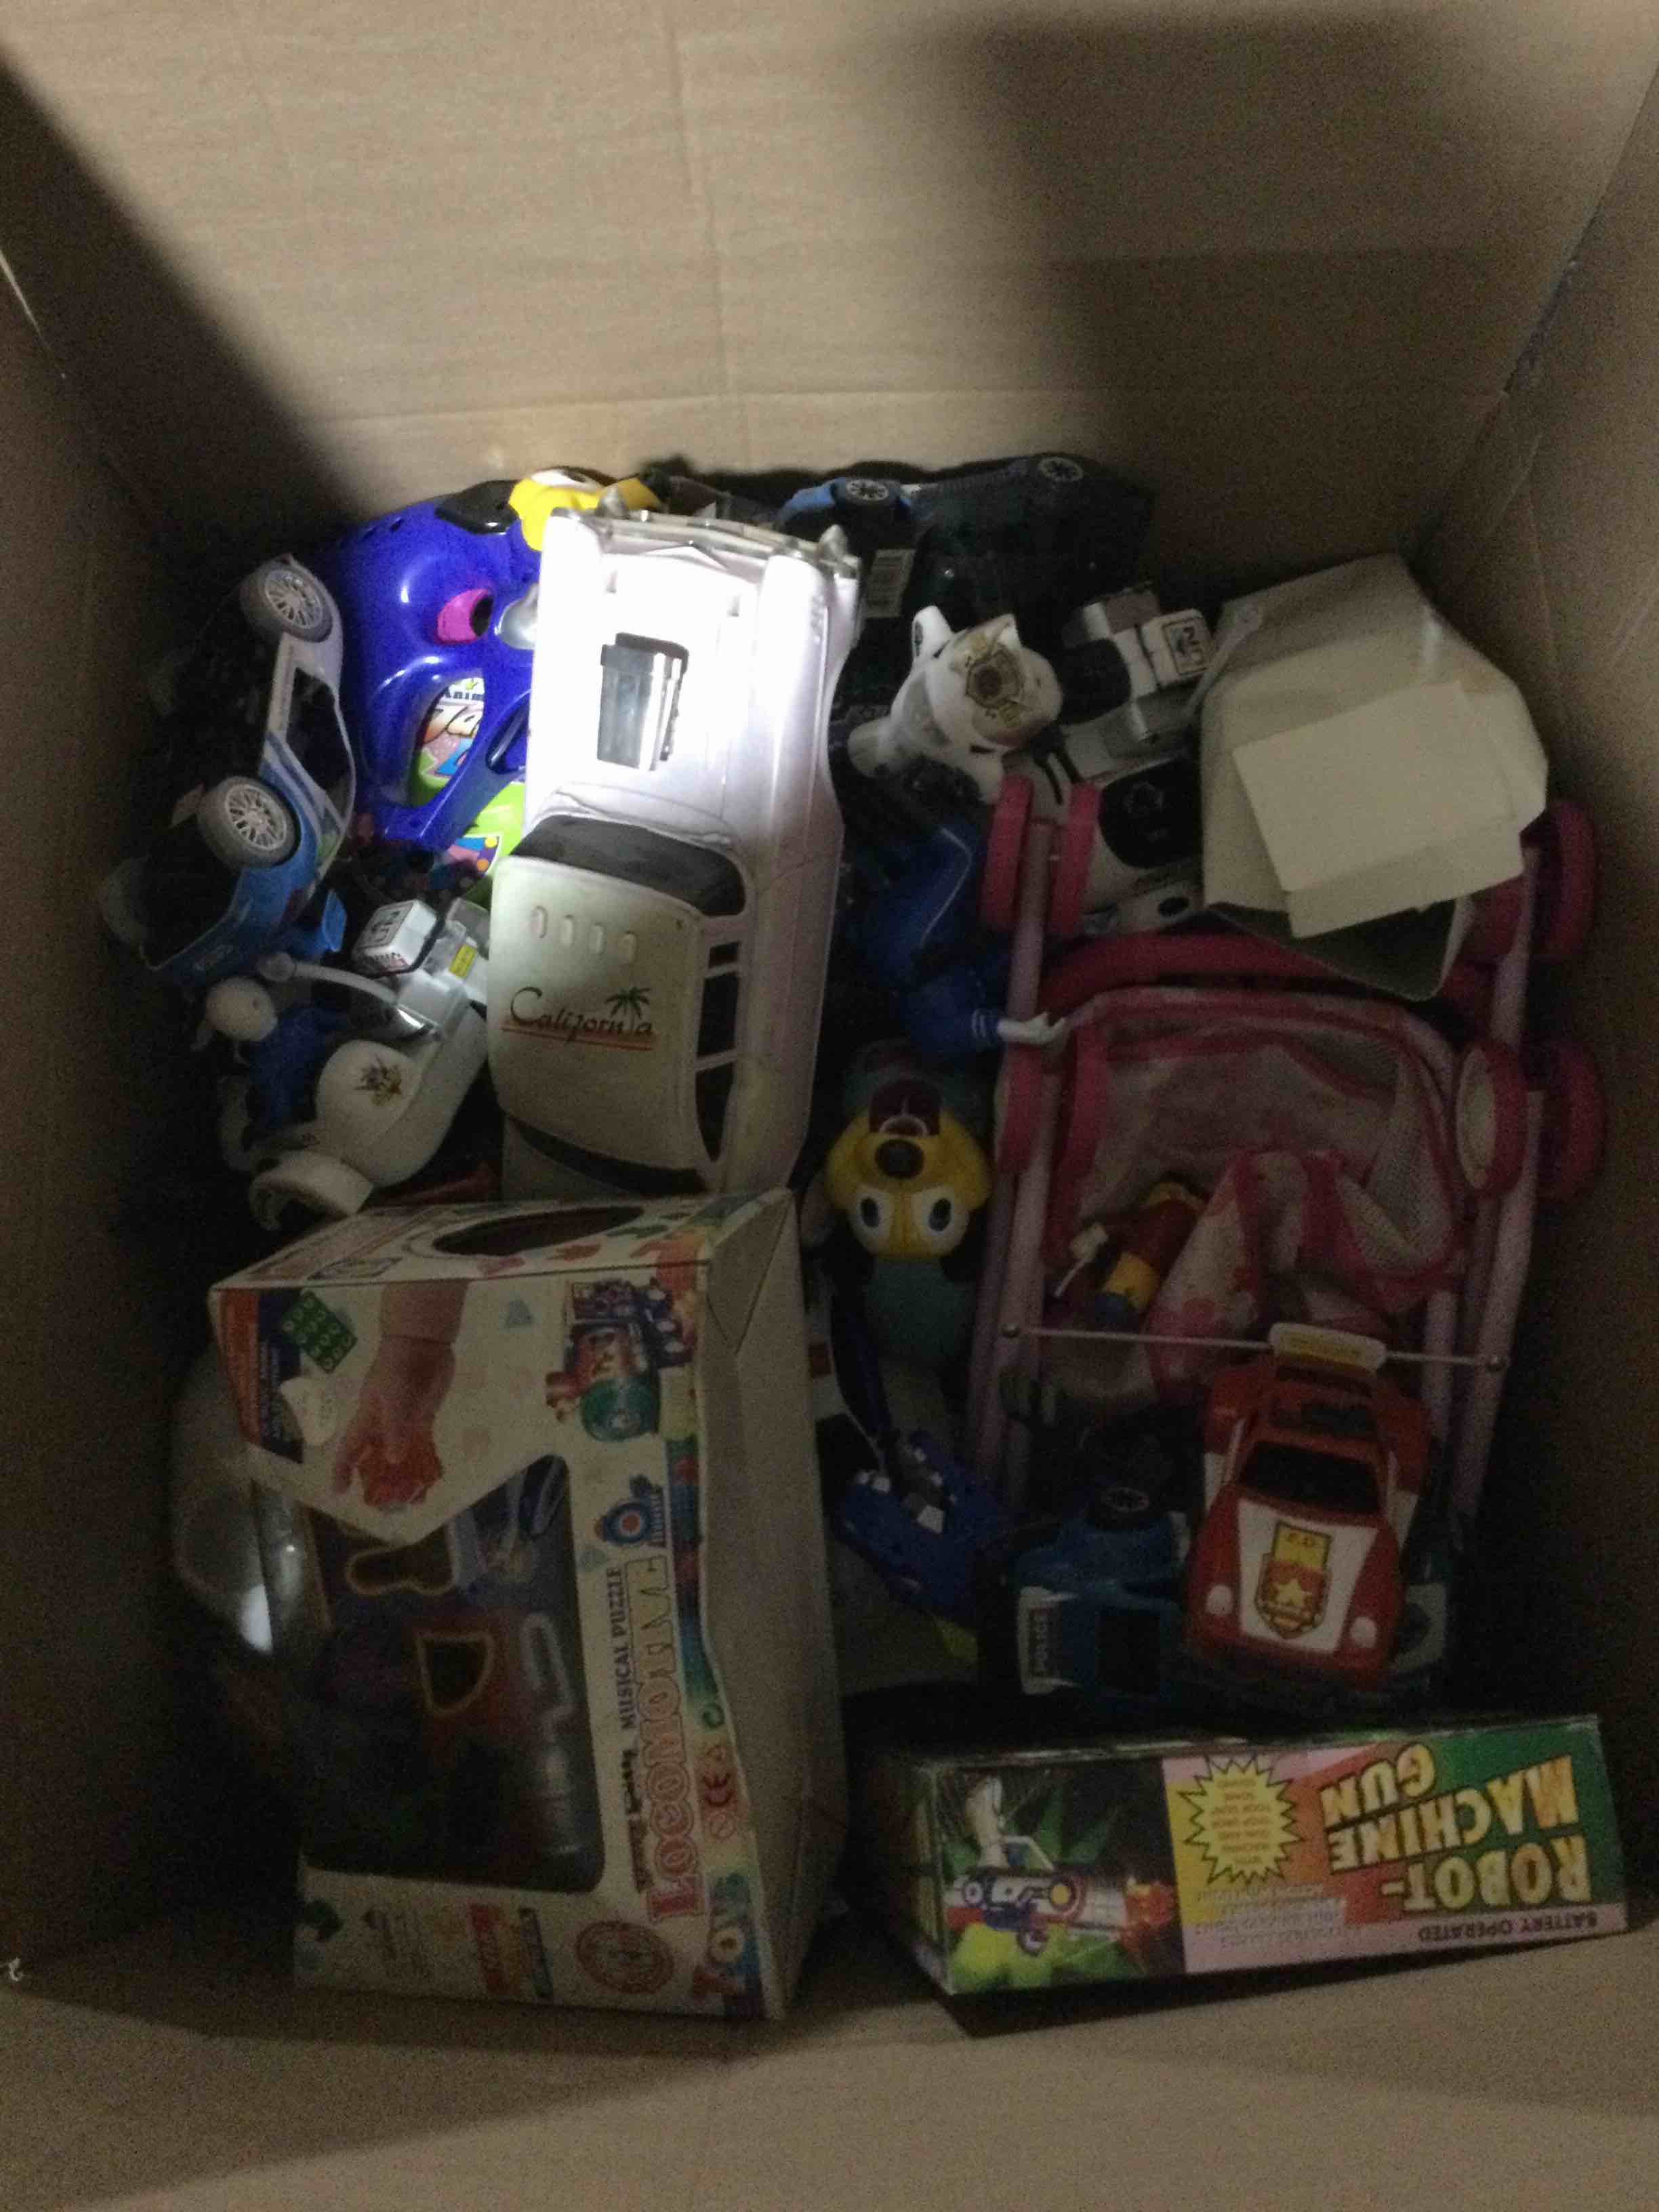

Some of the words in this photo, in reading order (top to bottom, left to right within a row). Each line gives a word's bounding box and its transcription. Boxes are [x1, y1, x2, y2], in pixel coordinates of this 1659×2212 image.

[510, 987, 653, 1043] California
[607, 1567, 626, 1637] PUZZLE
[613, 1644, 636, 1730] MUSICAL
[624, 1555, 703, 1922] LOCOMOTIVE
[1318, 1742, 1437, 1827] GUN
[1328, 1754, 1580, 1875] MACHINE
[1379, 1835, 1593, 1912] ROBOT-
[1418, 1920, 1513, 1942] OPERATED
[1521, 1911, 1597, 1933] BATTERY
